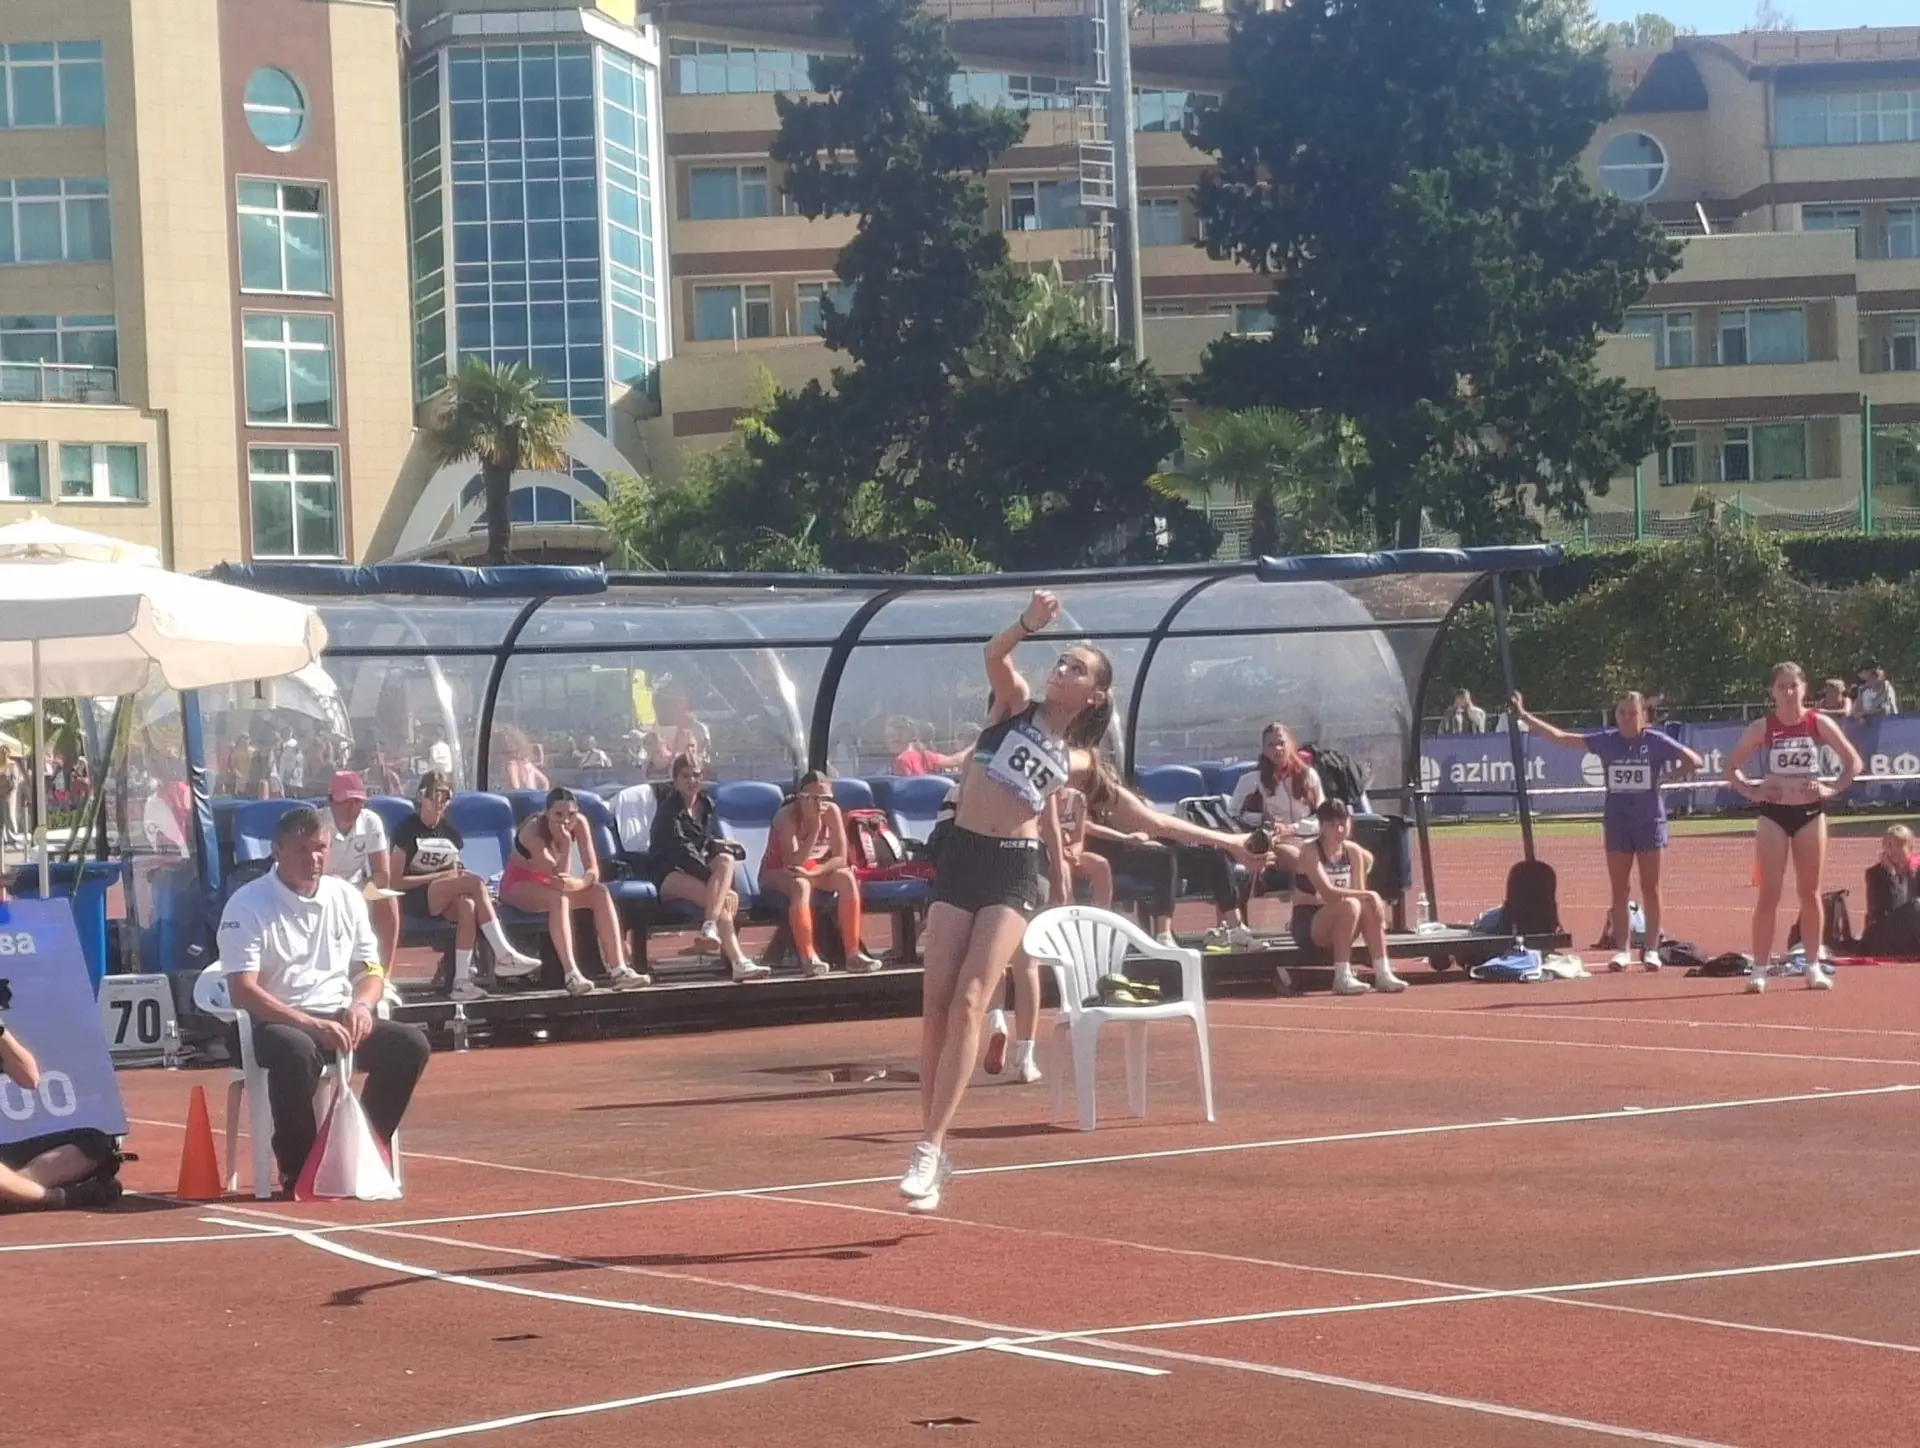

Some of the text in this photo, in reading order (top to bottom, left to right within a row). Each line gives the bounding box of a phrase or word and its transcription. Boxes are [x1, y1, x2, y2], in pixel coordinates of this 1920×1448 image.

[1008, 746, 1054, 790] 815
[1778, 752, 1811, 768] 842
[1614, 770, 1644, 784] 598
[110, 998, 161, 1045] 70
